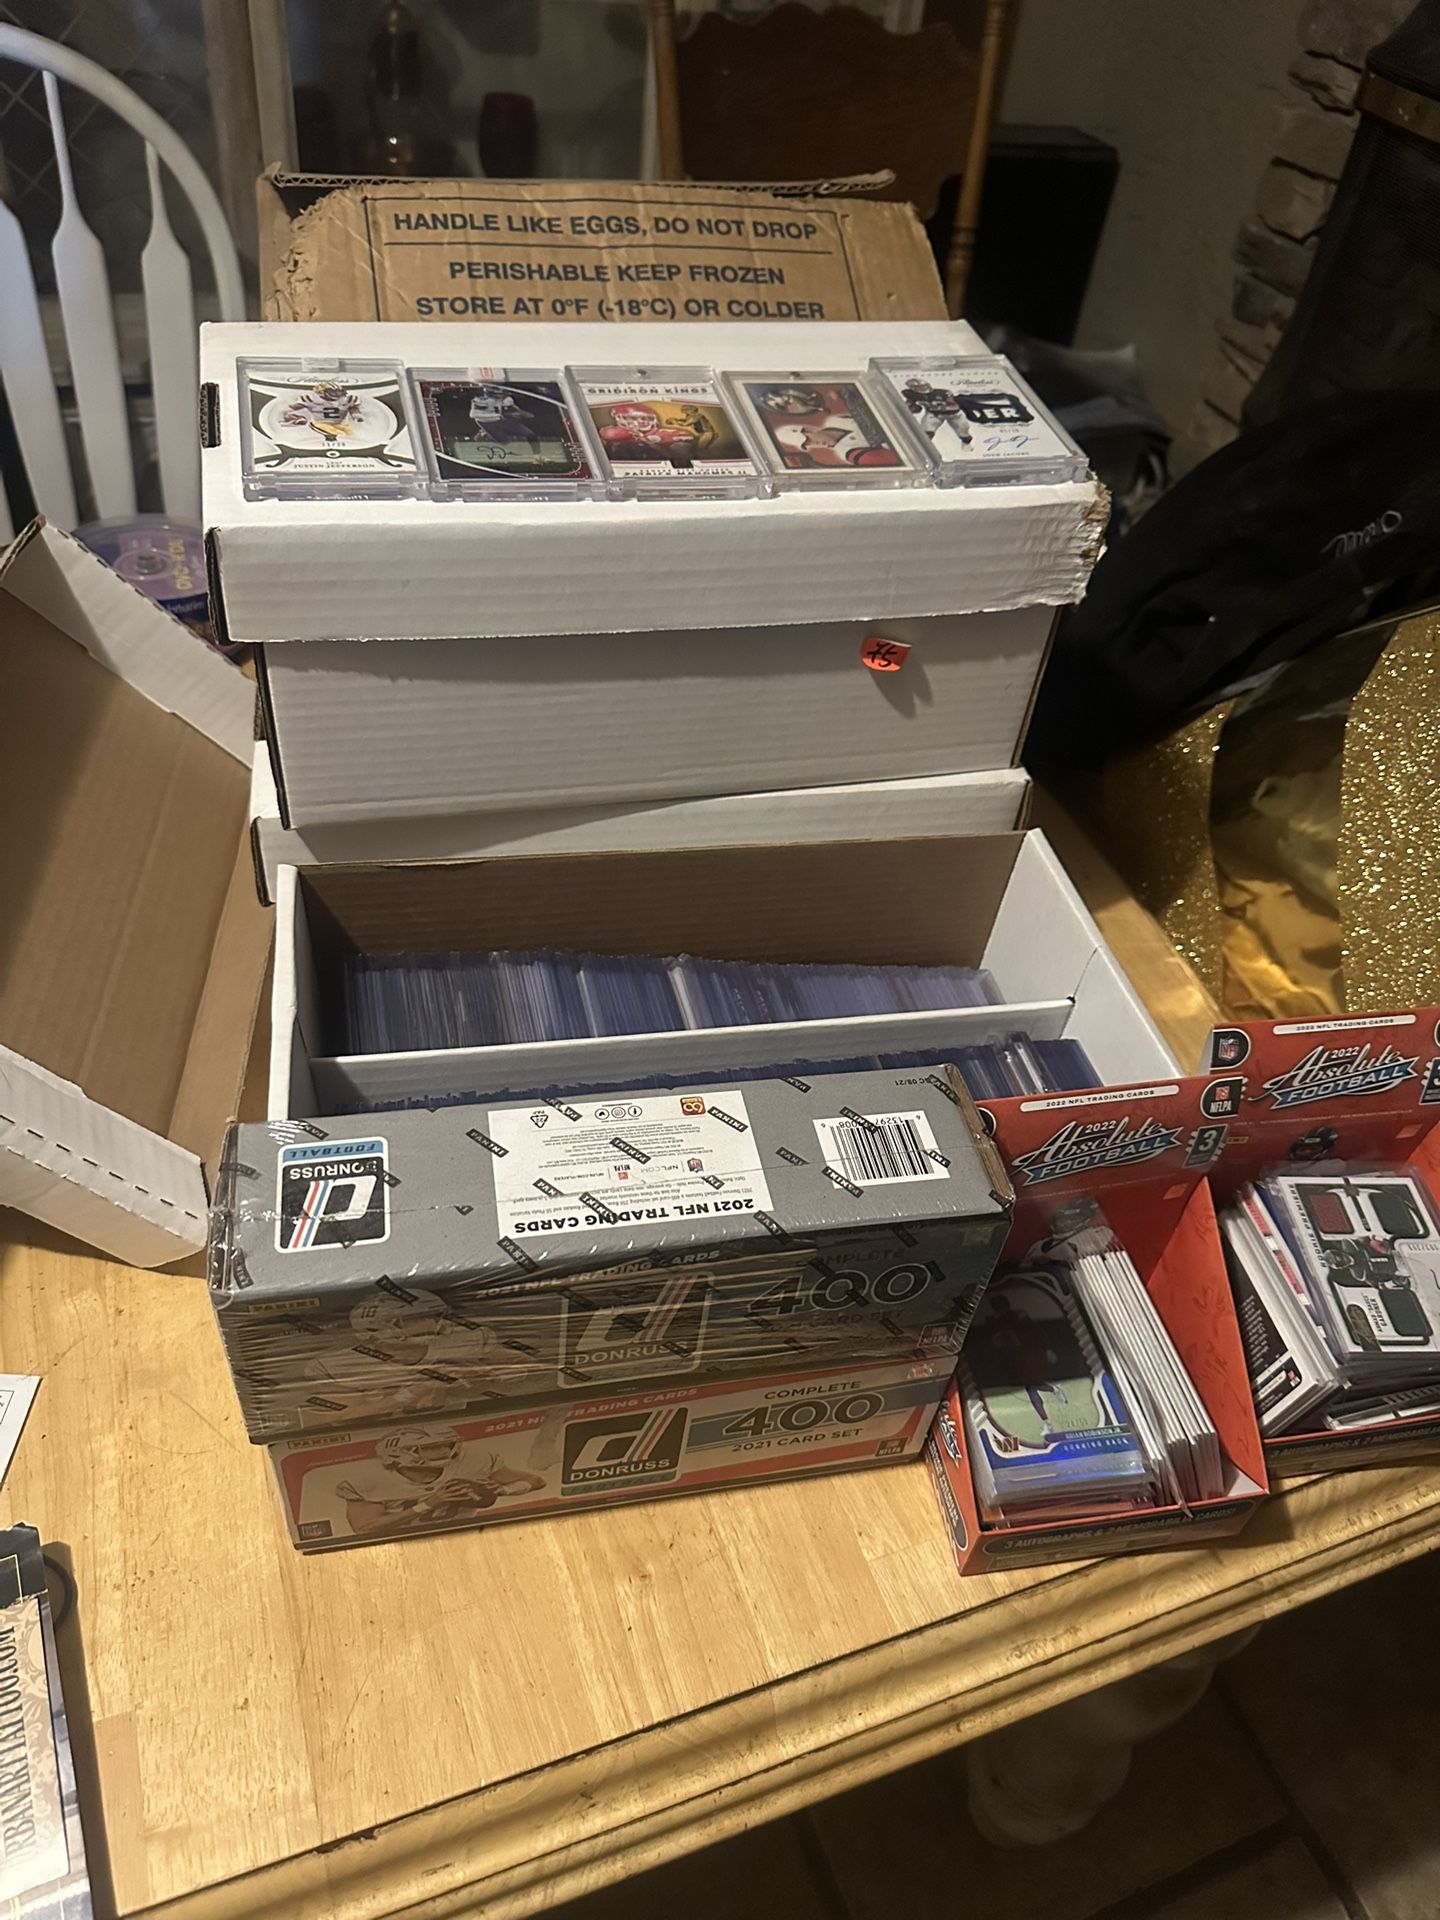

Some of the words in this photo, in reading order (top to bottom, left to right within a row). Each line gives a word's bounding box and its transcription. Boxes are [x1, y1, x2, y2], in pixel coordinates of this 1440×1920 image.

[394, 213, 500, 231] HANDLE
[507, 215, 563, 234] LIKE
[570, 215, 647, 237] EGGS,
[654, 216, 689, 234] DO
[697, 218, 745, 237] NOT
[752, 221, 817, 240] DROP
[449, 262, 611, 282] PERISHABLE
[617, 264, 682, 282] KEEP
[689, 265, 785, 284] FROZEN
[416, 297, 506, 315] STORE
[513, 298, 543, 315] AT
[684, 299, 720, 317] OR
[727, 300, 825, 319] COLDER
[588, 387, 659, 395] GRIDIRON
[1316, 1023, 1332, 1031] NFL
[1333, 1019, 1367, 1029] TRADING
[1368, 1017, 1395, 1026] CARDS
[1331, 1046, 1360, 1058] 2022
[1259, 1043, 1405, 1091] Absolute
[1288, 1067, 1405, 1102] FOOTBALL
[1046, 1099, 1067, 1108] 2022
[1068, 1097, 1085, 1105] NFL
[1087, 1093, 1125, 1103] TRADING
[1127, 1090, 1155, 1099] CARDS
[1209, 1099, 1232, 1113] NFLPA
[711, 1108, 743, 1130] PANINI
[875, 1116, 904, 1128] 13297
[1085, 1120, 1118, 1134] 2022
[289, 1143, 376, 1158] FOOTBALL
[470, 1131, 504, 1156] PANINI
[1011, 1116, 1168, 1168] Absolute
[1199, 1130, 1216, 1152] 3
[613, 1164, 631, 1172] NFLPA
[1040, 1137, 1167, 1179] FOOTBALL
[673, 1203, 709, 1216] NFL
[713, 1199, 754, 1212] 2021
[514, 1217, 579, 1233] CARDS
[523, 1278, 563, 1290] NFL
[567, 1261, 653, 1282] TRADING
[764, 1380, 862, 1400] COMPLETE
[485, 1420, 524, 1433] 2021
[643, 1388, 698, 1404] CARDS
[722, 1392, 886, 1437] 400
[732, 1440, 772, 1453] 2021
[777, 1432, 826, 1447] CARD
[832, 1427, 864, 1439] SET
[570, 1458, 671, 1481] DONRUSS
